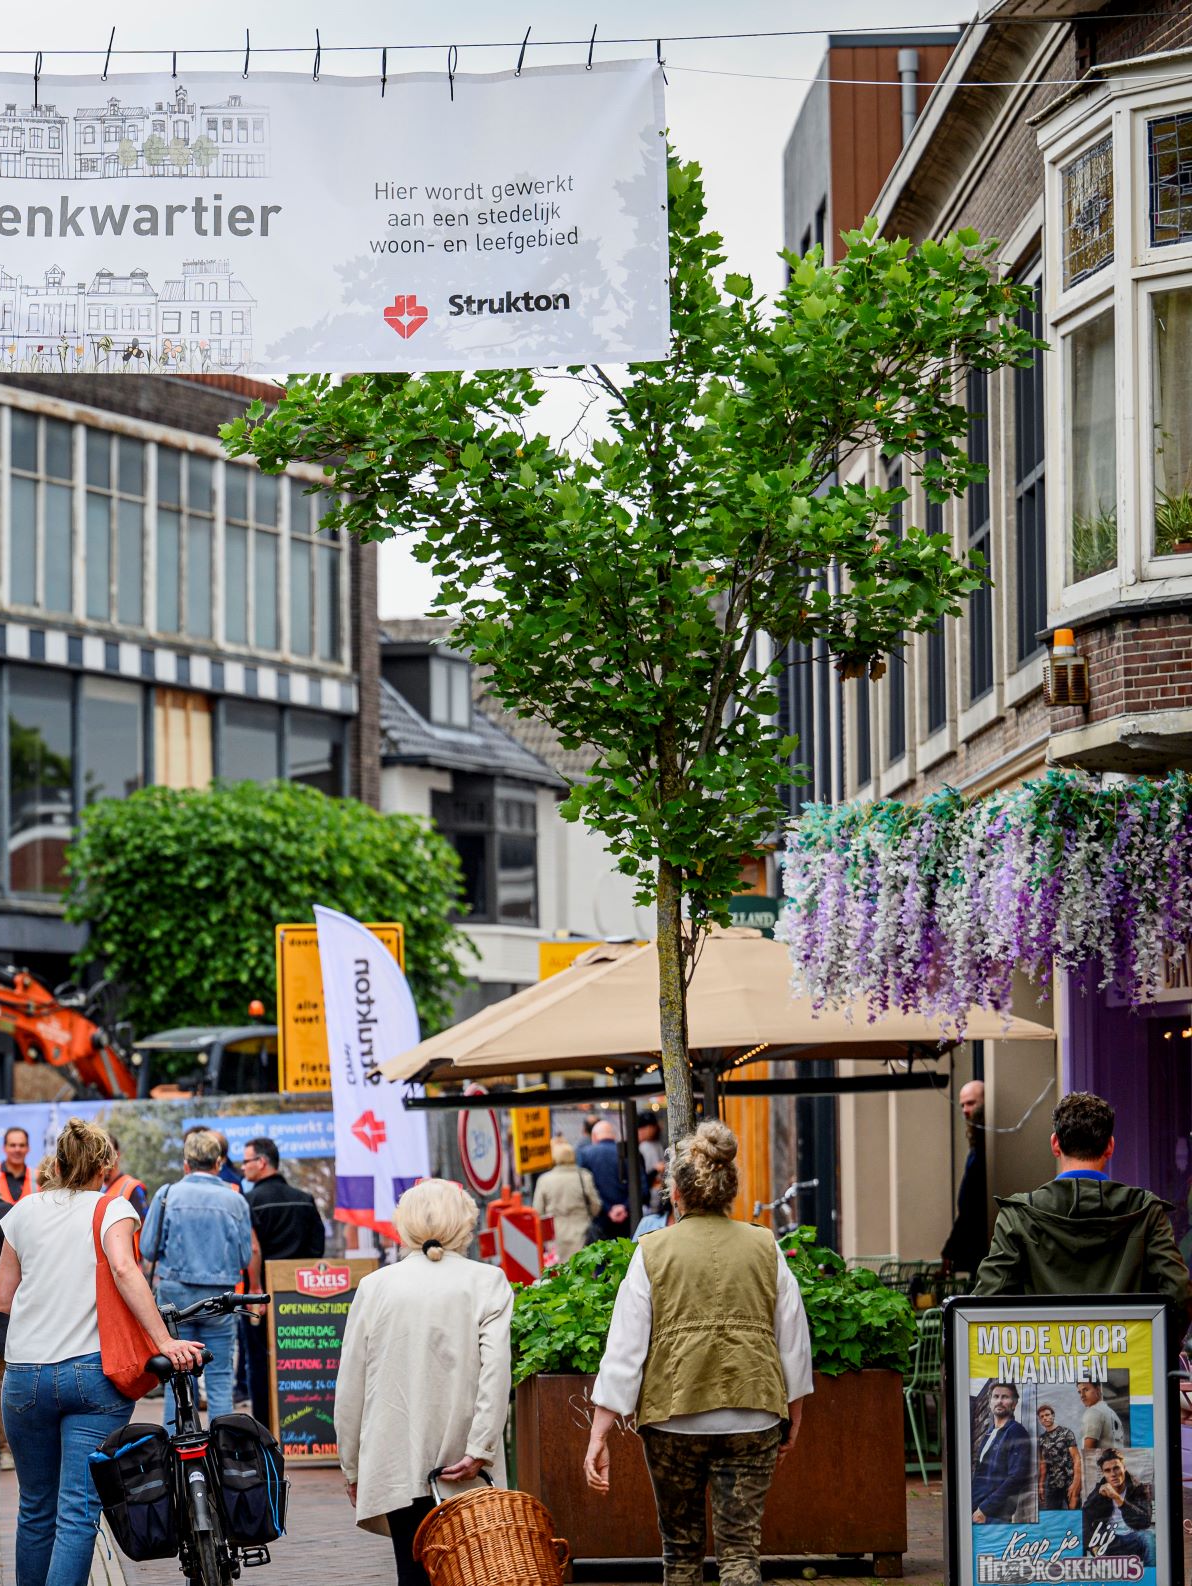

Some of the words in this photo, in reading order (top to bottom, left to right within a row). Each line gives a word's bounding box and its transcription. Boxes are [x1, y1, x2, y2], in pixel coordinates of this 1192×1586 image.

[374, 181, 418, 200] Hier
[425, 182, 483, 200] wordt
[491, 174, 574, 203] gewerkt
[387, 212, 425, 227] aan
[433, 212, 469, 227] een
[477, 202, 561, 226] stedelijk
[370, 239, 435, 254] woon-
[443, 239, 468, 253] en
[476, 226, 579, 255] leefgebied
[449, 291, 570, 317] Strukton
[300, 1062, 331, 1073] fiets
[268, 1120, 324, 1138] gewerkt
[277, 1325, 337, 1337] DONDERDAG
[977, 1325, 1052, 1355] MODE
[1057, 1325, 1128, 1354] VOOR
[997, 1355, 1109, 1385] MANNEN
[278, 1380, 313, 1391] ZONDAG
[1001, 1531, 1050, 1564] Koop
[1051, 1530, 1081, 1563] je
[1088, 1521, 1119, 1555] bij
